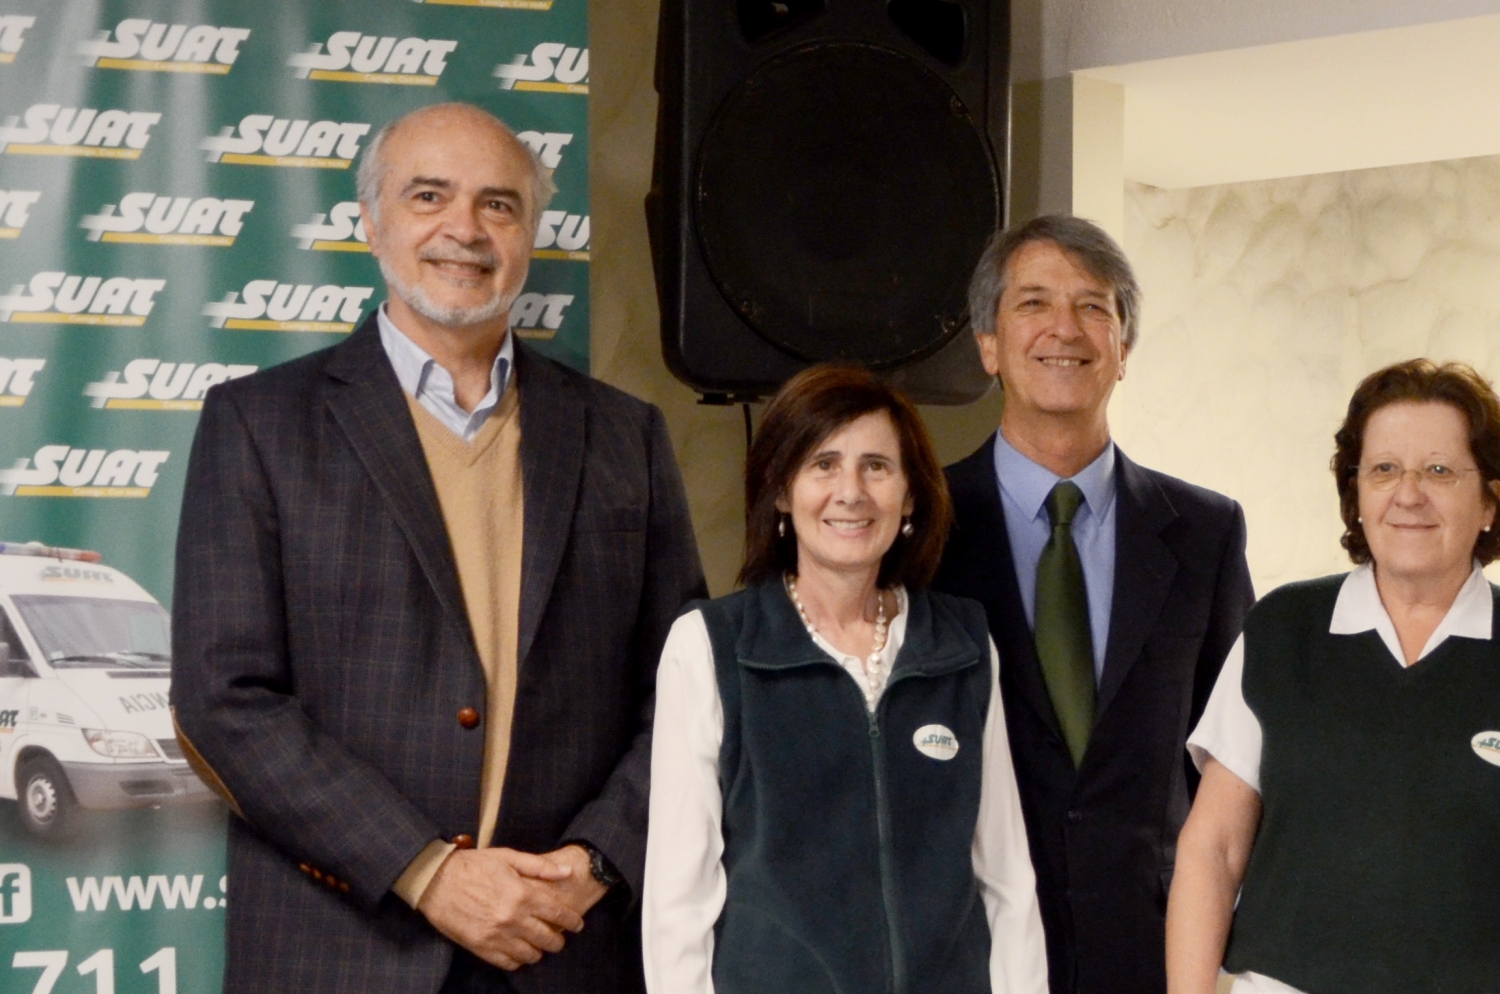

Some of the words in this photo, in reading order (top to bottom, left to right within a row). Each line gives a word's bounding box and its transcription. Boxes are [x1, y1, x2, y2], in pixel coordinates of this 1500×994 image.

[98, 18, 251, 64] SUAT
[312, 31, 458, 76] SUAT
[520, 42, 589, 83] SU
[12, 104, 162, 149] SUAT
[226, 114, 371, 159] SUAT
[108, 192, 255, 236] SUAT
[533, 210, 590, 250] SU
[17, 271, 166, 315] SUAT
[232, 279, 374, 323] SUAT
[509, 291, 575, 329] AT
[22, 445, 170, 488] SUAT
